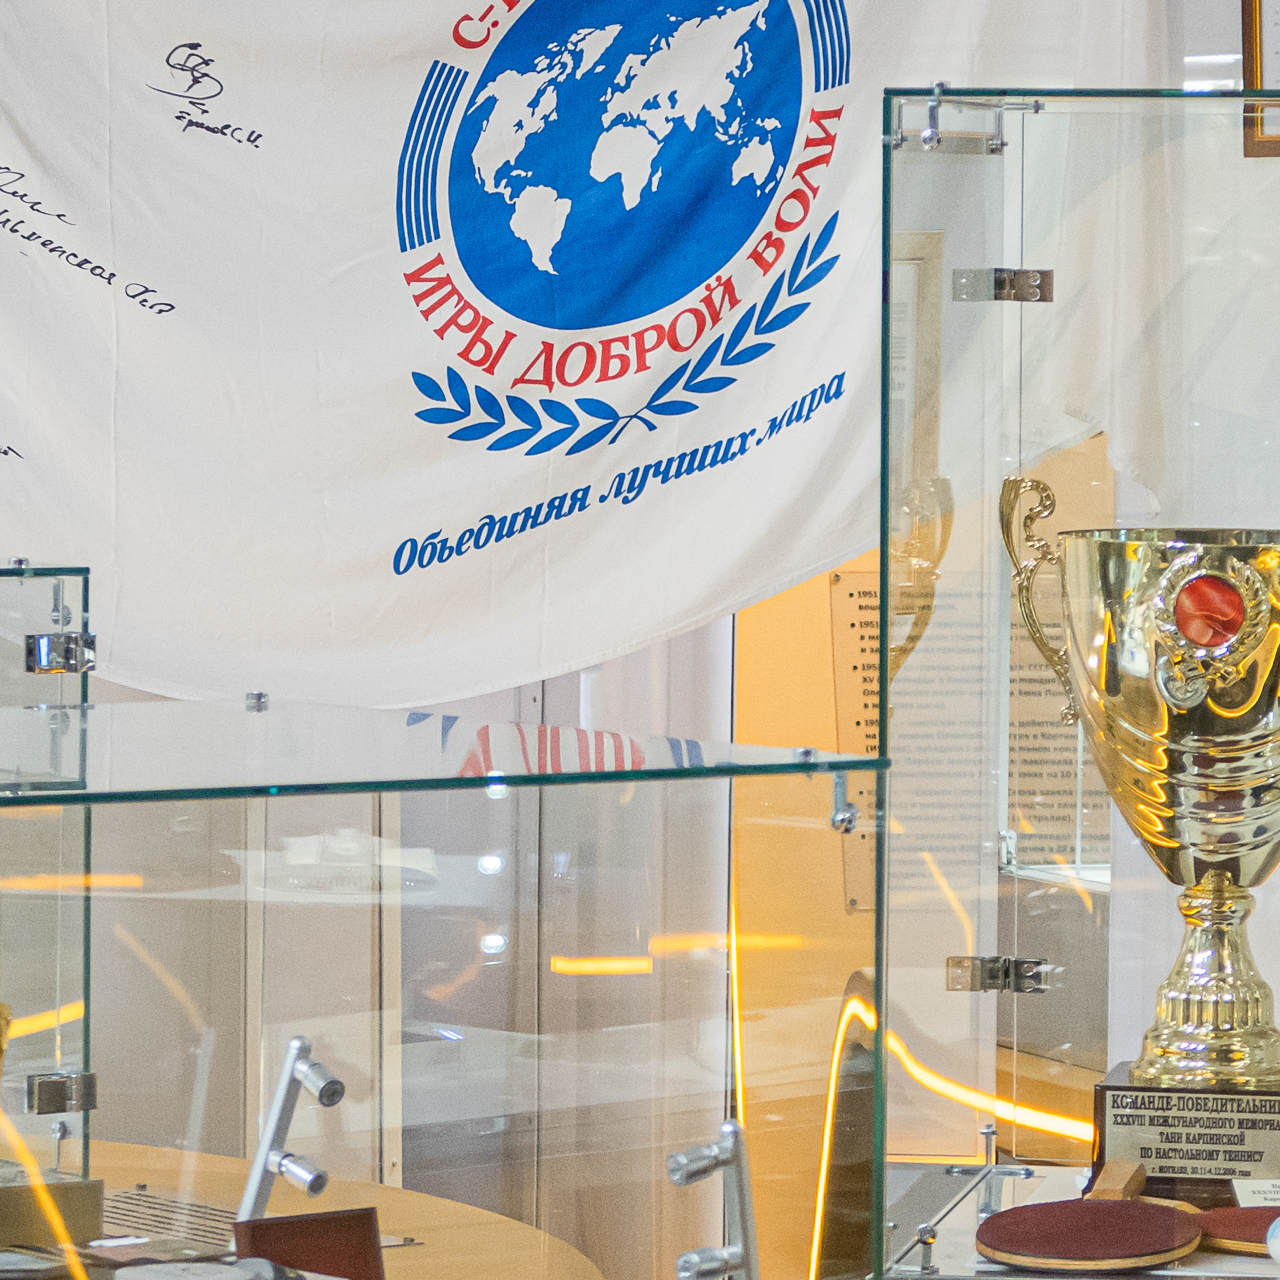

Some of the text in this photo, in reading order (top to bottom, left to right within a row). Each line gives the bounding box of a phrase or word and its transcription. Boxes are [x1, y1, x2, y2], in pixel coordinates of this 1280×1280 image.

[403, 104, 846, 394] ИГРЫ ДОБРОЙ ВОЛИ
[392, 370, 847, 576] Объединяя лучших мира
[857, 590, 878, 599] 1951
[1148, 1115, 1236, 1130] МЕЖДУНАРОДНОГО
[1159, 1131, 1246, 1146] ТАНИ КАРПИНСКОЙ
[1140, 1147, 1264, 1162] ПО НАСТОЛЬНОМУ ТЕННИСУ
